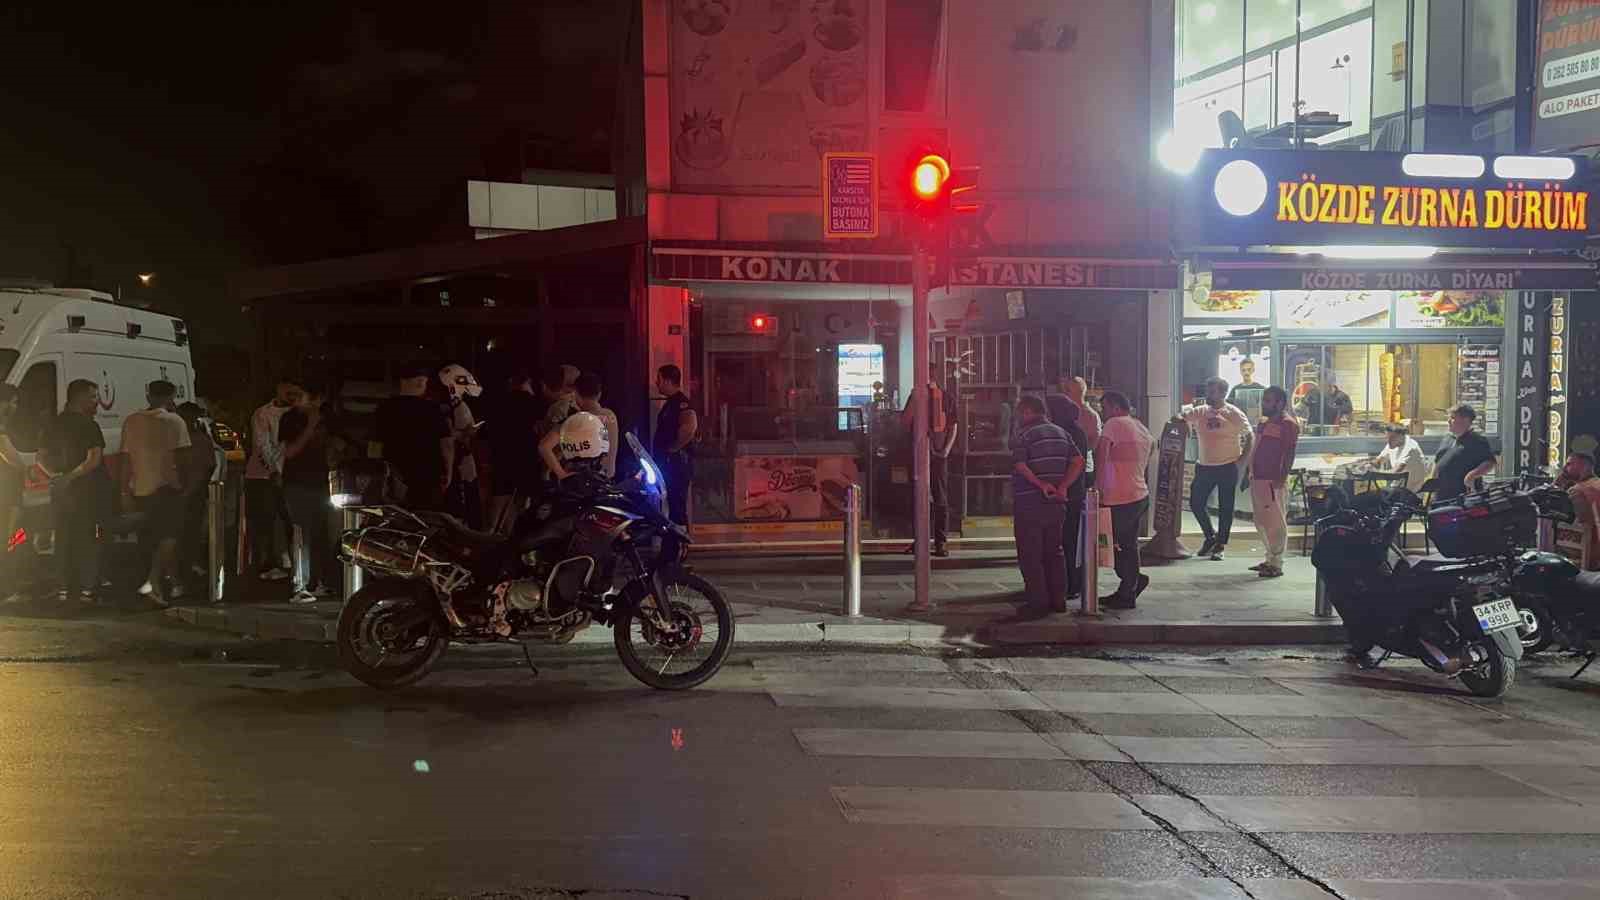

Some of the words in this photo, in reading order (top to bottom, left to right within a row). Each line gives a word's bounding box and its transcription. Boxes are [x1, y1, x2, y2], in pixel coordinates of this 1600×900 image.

[1543, 101, 1564, 114] ALO
[1276, 173, 1375, 224] KÖZDE
[1382, 184, 1477, 228] ZURNA
[1484, 182, 1588, 230] DÜRÜM
[720, 255, 840, 281] KONAK
[1301, 269, 1366, 288] KÖZDE
[1377, 271, 1440, 288] ZURNA
[1551, 298, 1563, 391] ZURNA
[1476, 607, 1490, 617] 34
[1491, 600, 1511, 613] KRP
[1488, 613, 1509, 625] 998
